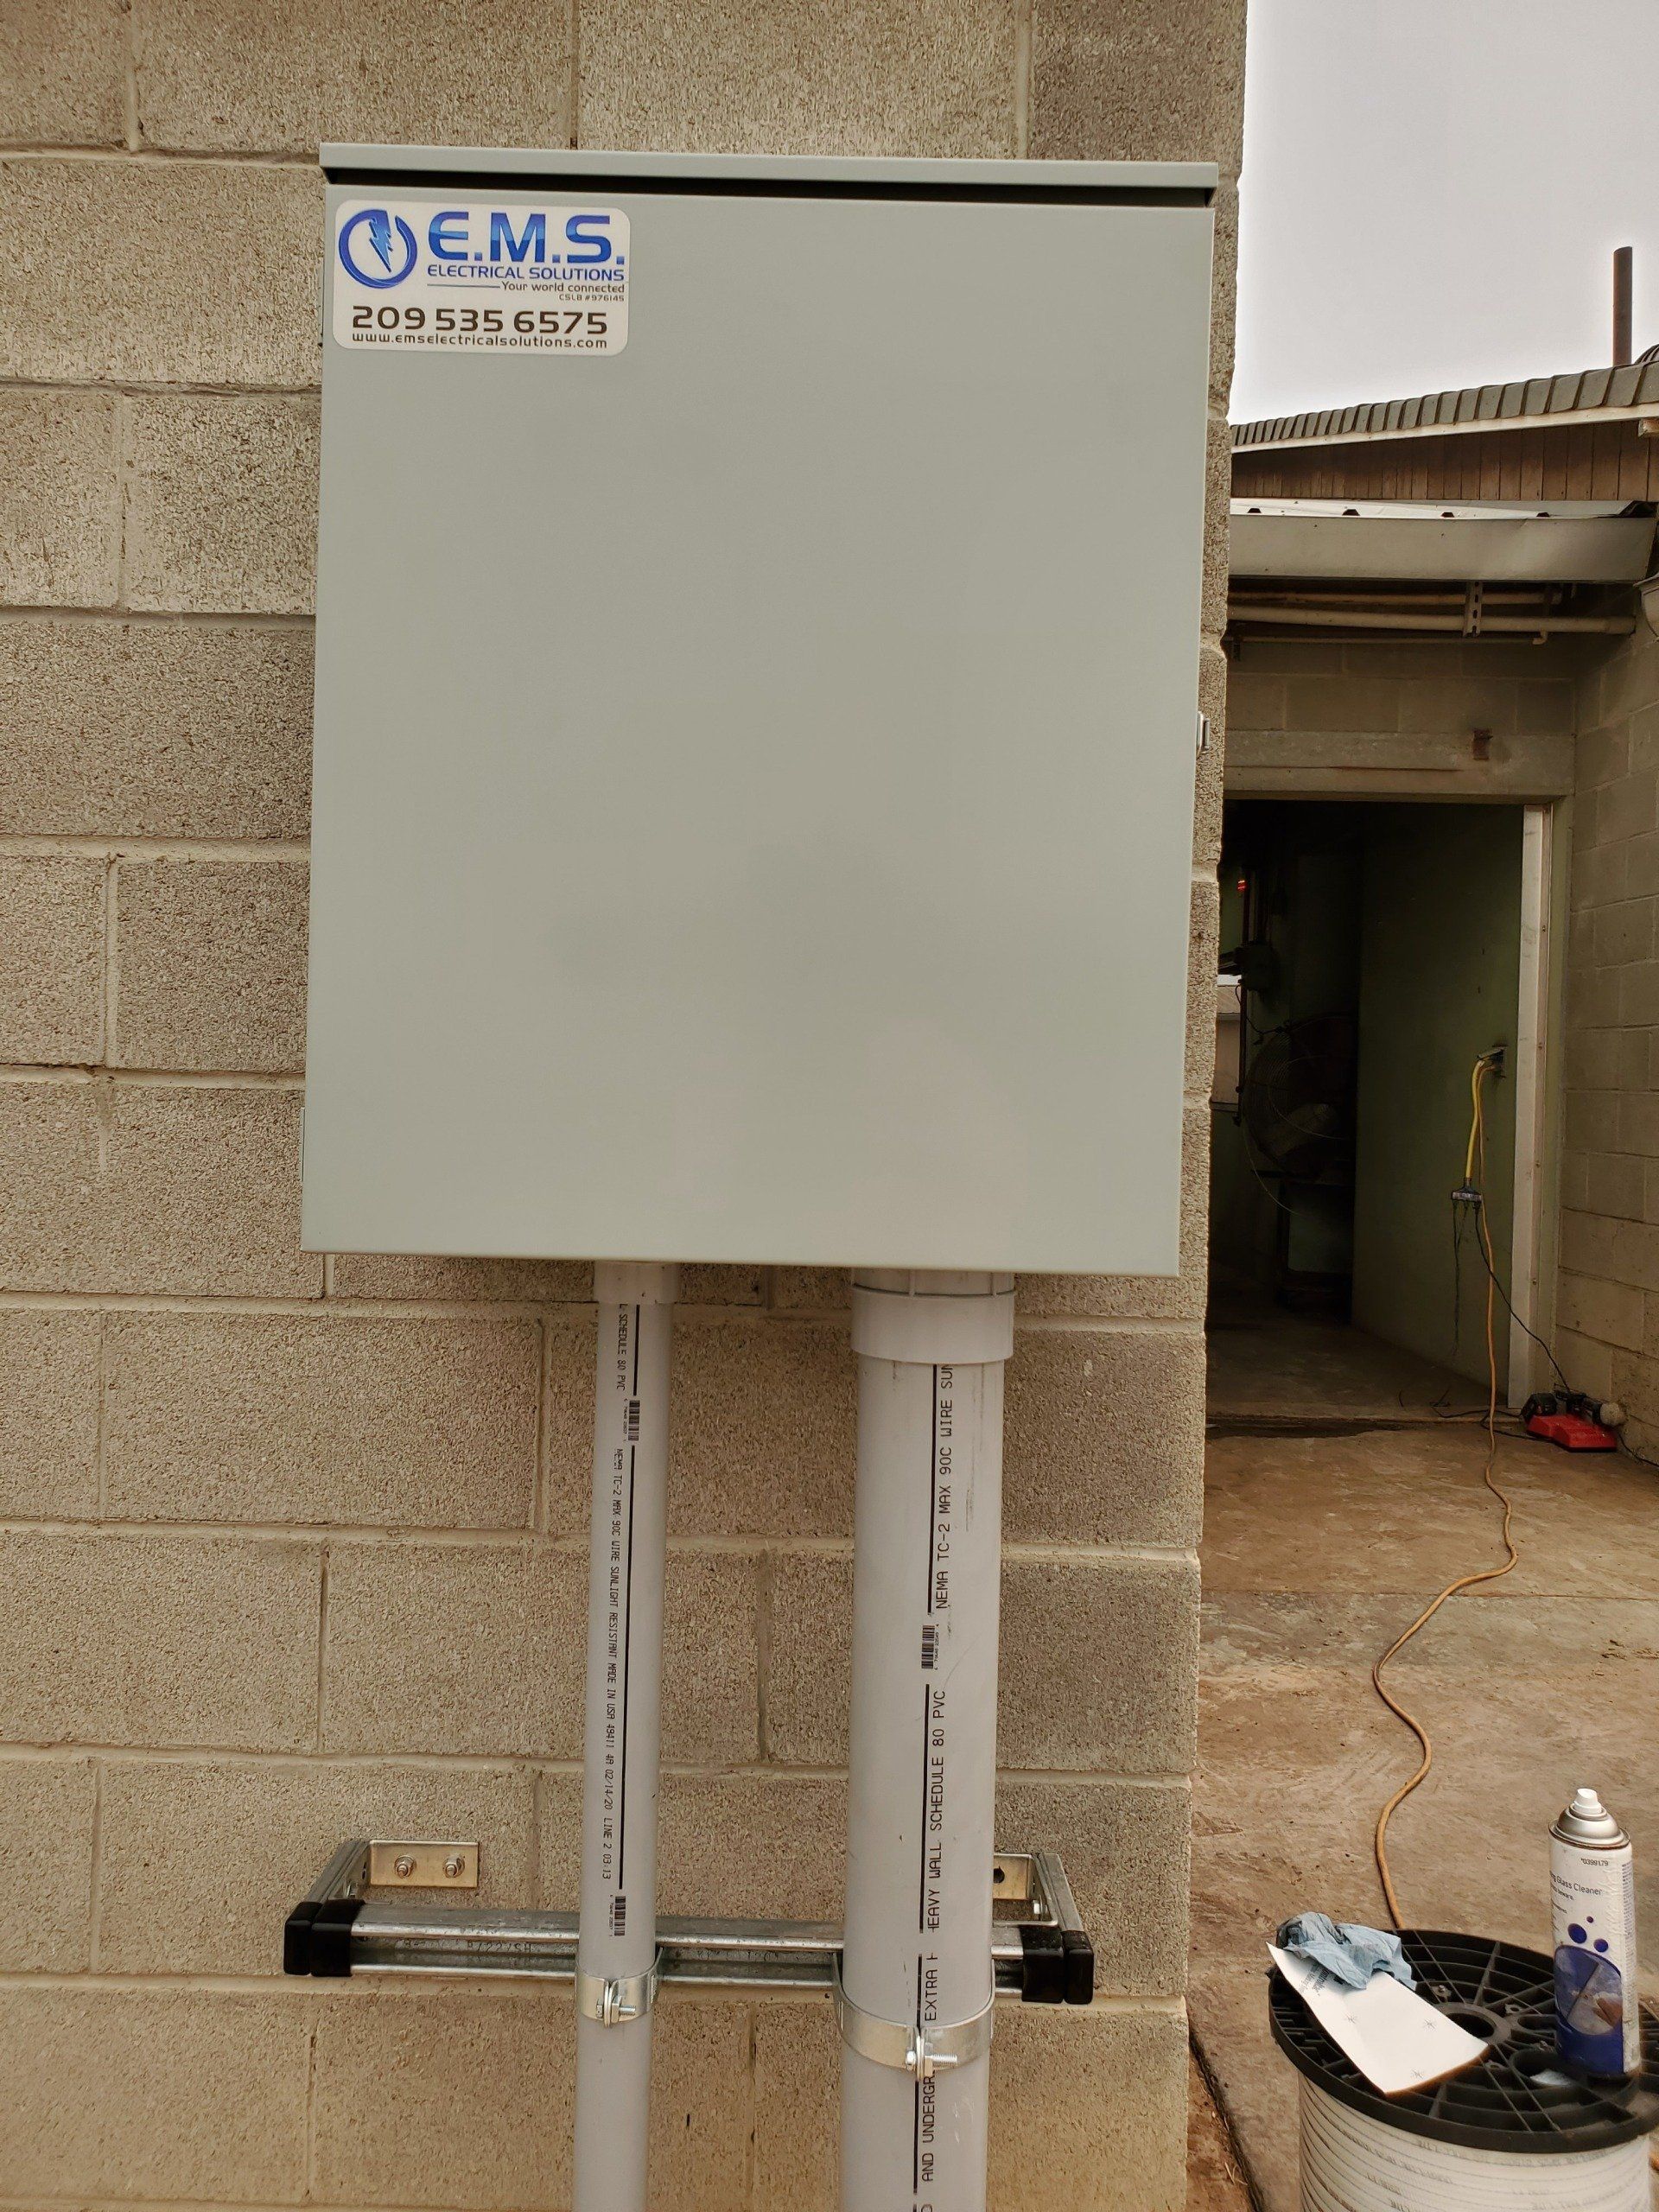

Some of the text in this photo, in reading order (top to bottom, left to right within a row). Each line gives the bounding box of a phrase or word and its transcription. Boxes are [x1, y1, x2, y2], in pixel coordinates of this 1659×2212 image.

[427, 211, 625, 265] E.M.S.
[427, 264, 625, 282] ELECTRICAL SOLUTIONS
[501, 281, 625, 294] Your world connected
[352, 305, 607, 335] 209 535 6575
[352, 333, 607, 349] www.emselectricalsolutions.com
[618, 1314, 627, 1354] SCHEDULE
[618, 1360, 626, 1370] 80
[617, 1375, 626, 1390] PVC
[940, 1400, 952, 1437] WIRE
[614, 1449, 623, 1470] NEMA
[939, 1447, 951, 1474] 90C
[613, 1475, 622, 1495] TC-2
[613, 1500, 621, 1516] MAX
[939, 1485, 950, 1513] MAX
[612, 1521, 620, 1535] 90C
[611, 1541, 620, 1561] WIRE
[938, 1524, 950, 1561] TC-2
[610, 1567, 619, 1607] SUNLIGHT
[936, 1572, 950, 1609] NEMA
[608, 1612, 618, 1658] RESISTANT
[607, 1663, 616, 1683] MADE
[607, 1689, 616, 1699] IN
[933, 1691, 945, 1718] PVC
[607, 1704, 615, 1719] USA
[932, 1729, 944, 1746] 80
[605, 1770, 613, 1809] 02/14/20
[931, 1757, 944, 1831] SCHEDULE
[602, 1854, 611, 1879] 03:13
[929, 1842, 941, 1878] WALL
[1557, 1876, 1573, 1889] Glass
[1573, 1883, 1604, 1896] Cleaner
[925, 1969, 938, 2021] EXTRA
[922, 2073, 936, 2182] AND UNDERGR
